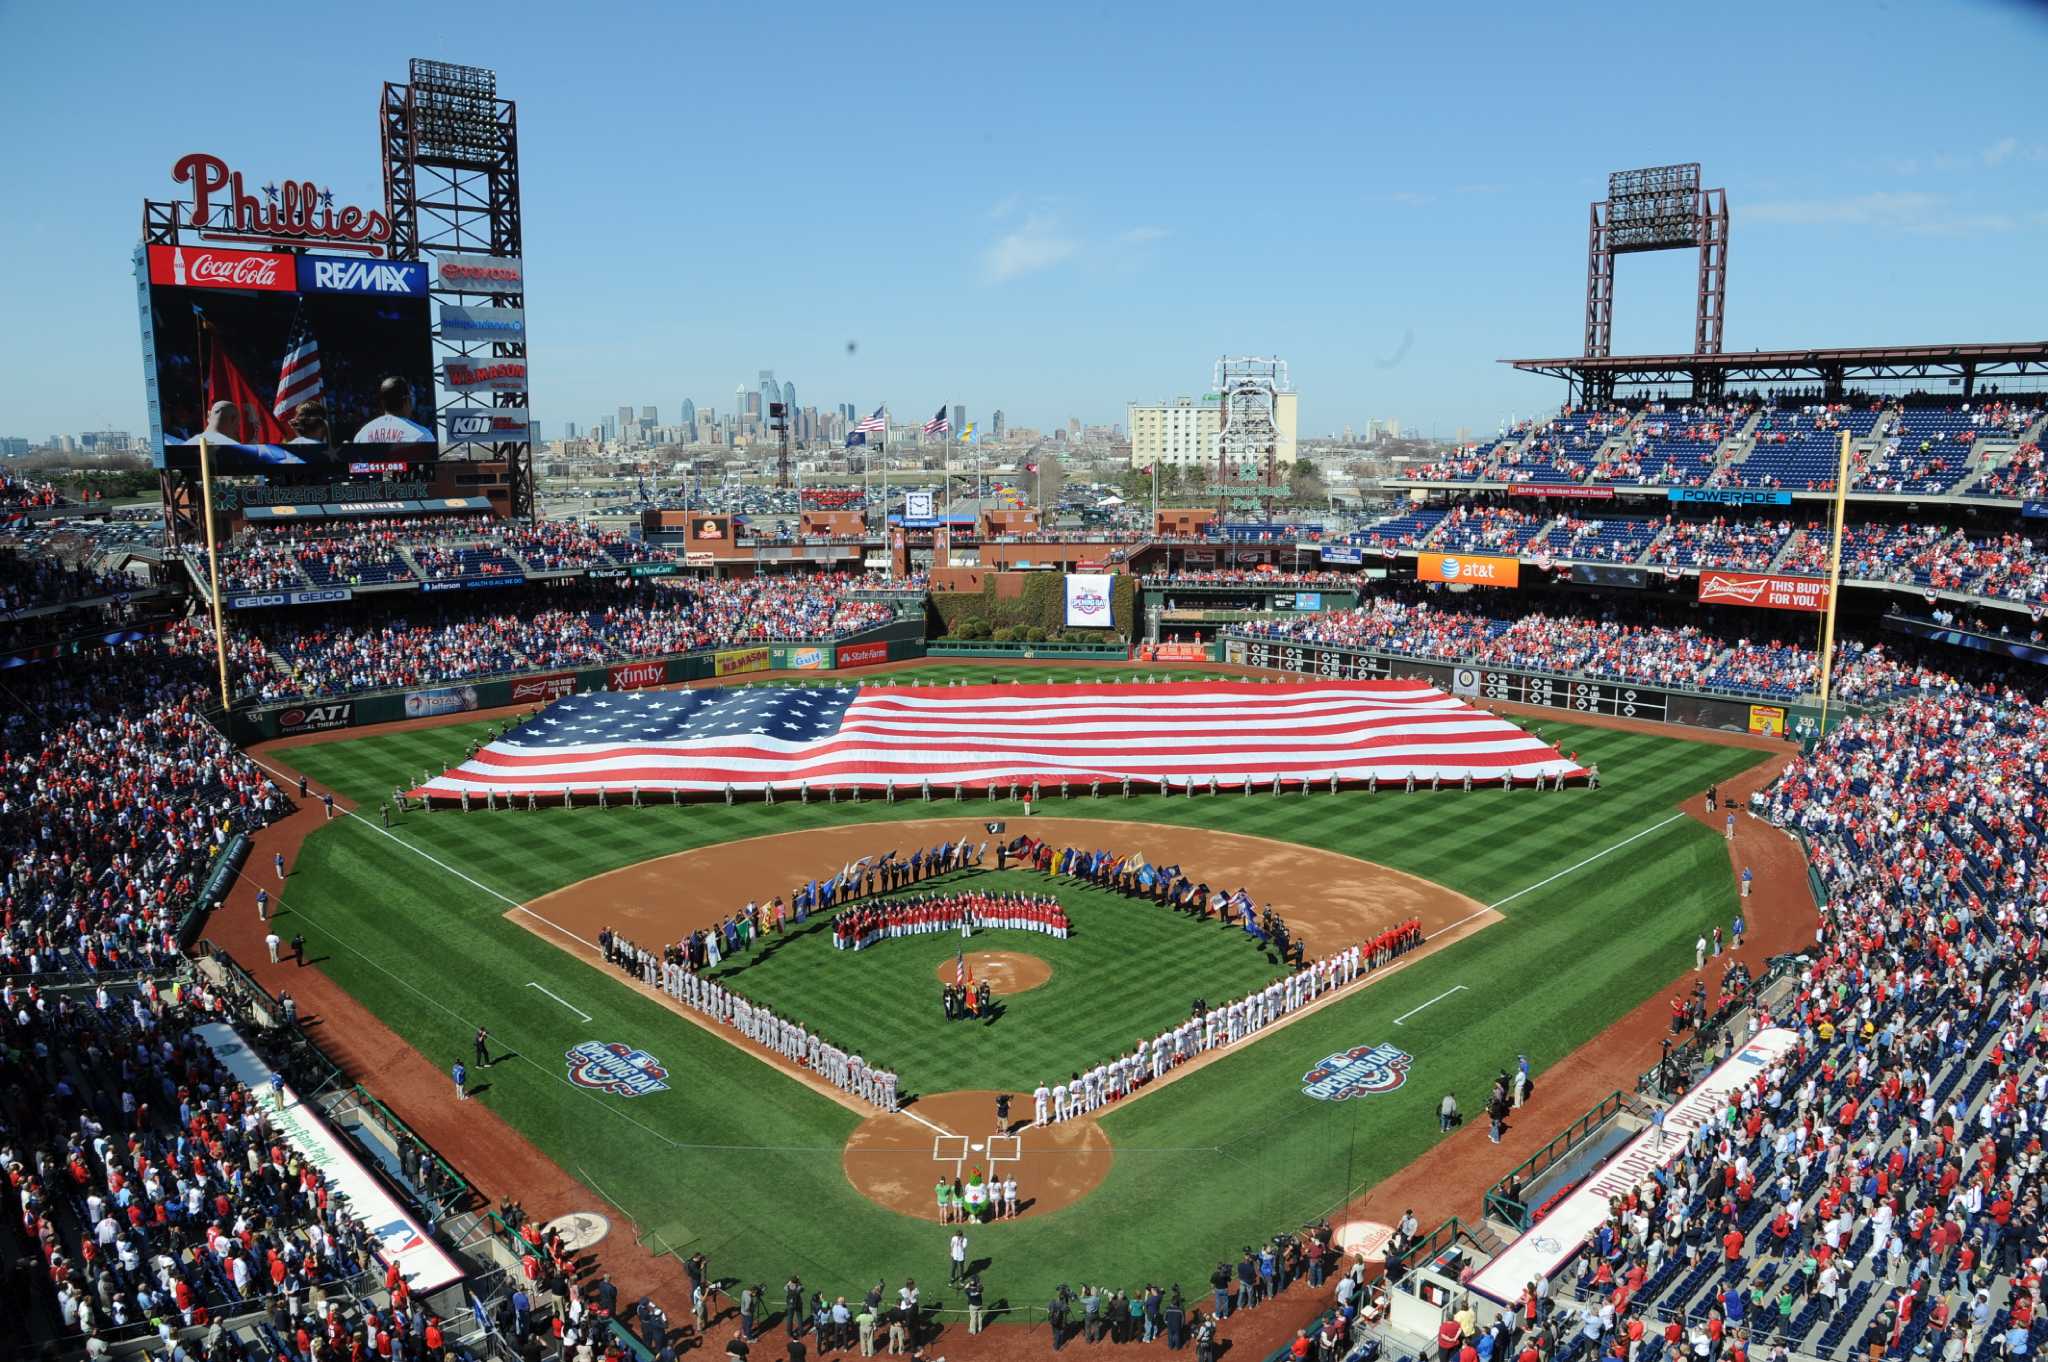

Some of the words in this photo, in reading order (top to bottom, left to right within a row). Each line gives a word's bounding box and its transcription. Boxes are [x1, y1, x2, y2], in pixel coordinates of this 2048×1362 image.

[172, 153, 392, 242] Phillies
[191, 253, 280, 285] Coca-Cola
[315, 261, 410, 292] RE/MAX
[241, 484, 327, 505] Citizens
[331, 481, 382, 501] Bank
[385, 479, 428, 499] Park
[1683, 489, 1776, 503] POWERADE
[1462, 563, 1495, 578] at&t
[299, 589, 345, 601] GEICO
[1769, 580, 1794, 592] THIS
[1797, 582, 1830, 595] BUD'S
[235, 594, 284, 608] GEICO
[1769, 594, 1790, 606] FOR
[1793, 596, 1817, 607] YOU.
[614, 665, 664, 688] xfinity
[304, 704, 350, 723] ATI
[577, 1042, 640, 1080] OPENING
[624, 1074, 665, 1094] DAY
[1303, 1059, 1379, 1099] OPENING
[1364, 1044, 1403, 1068] DAY
